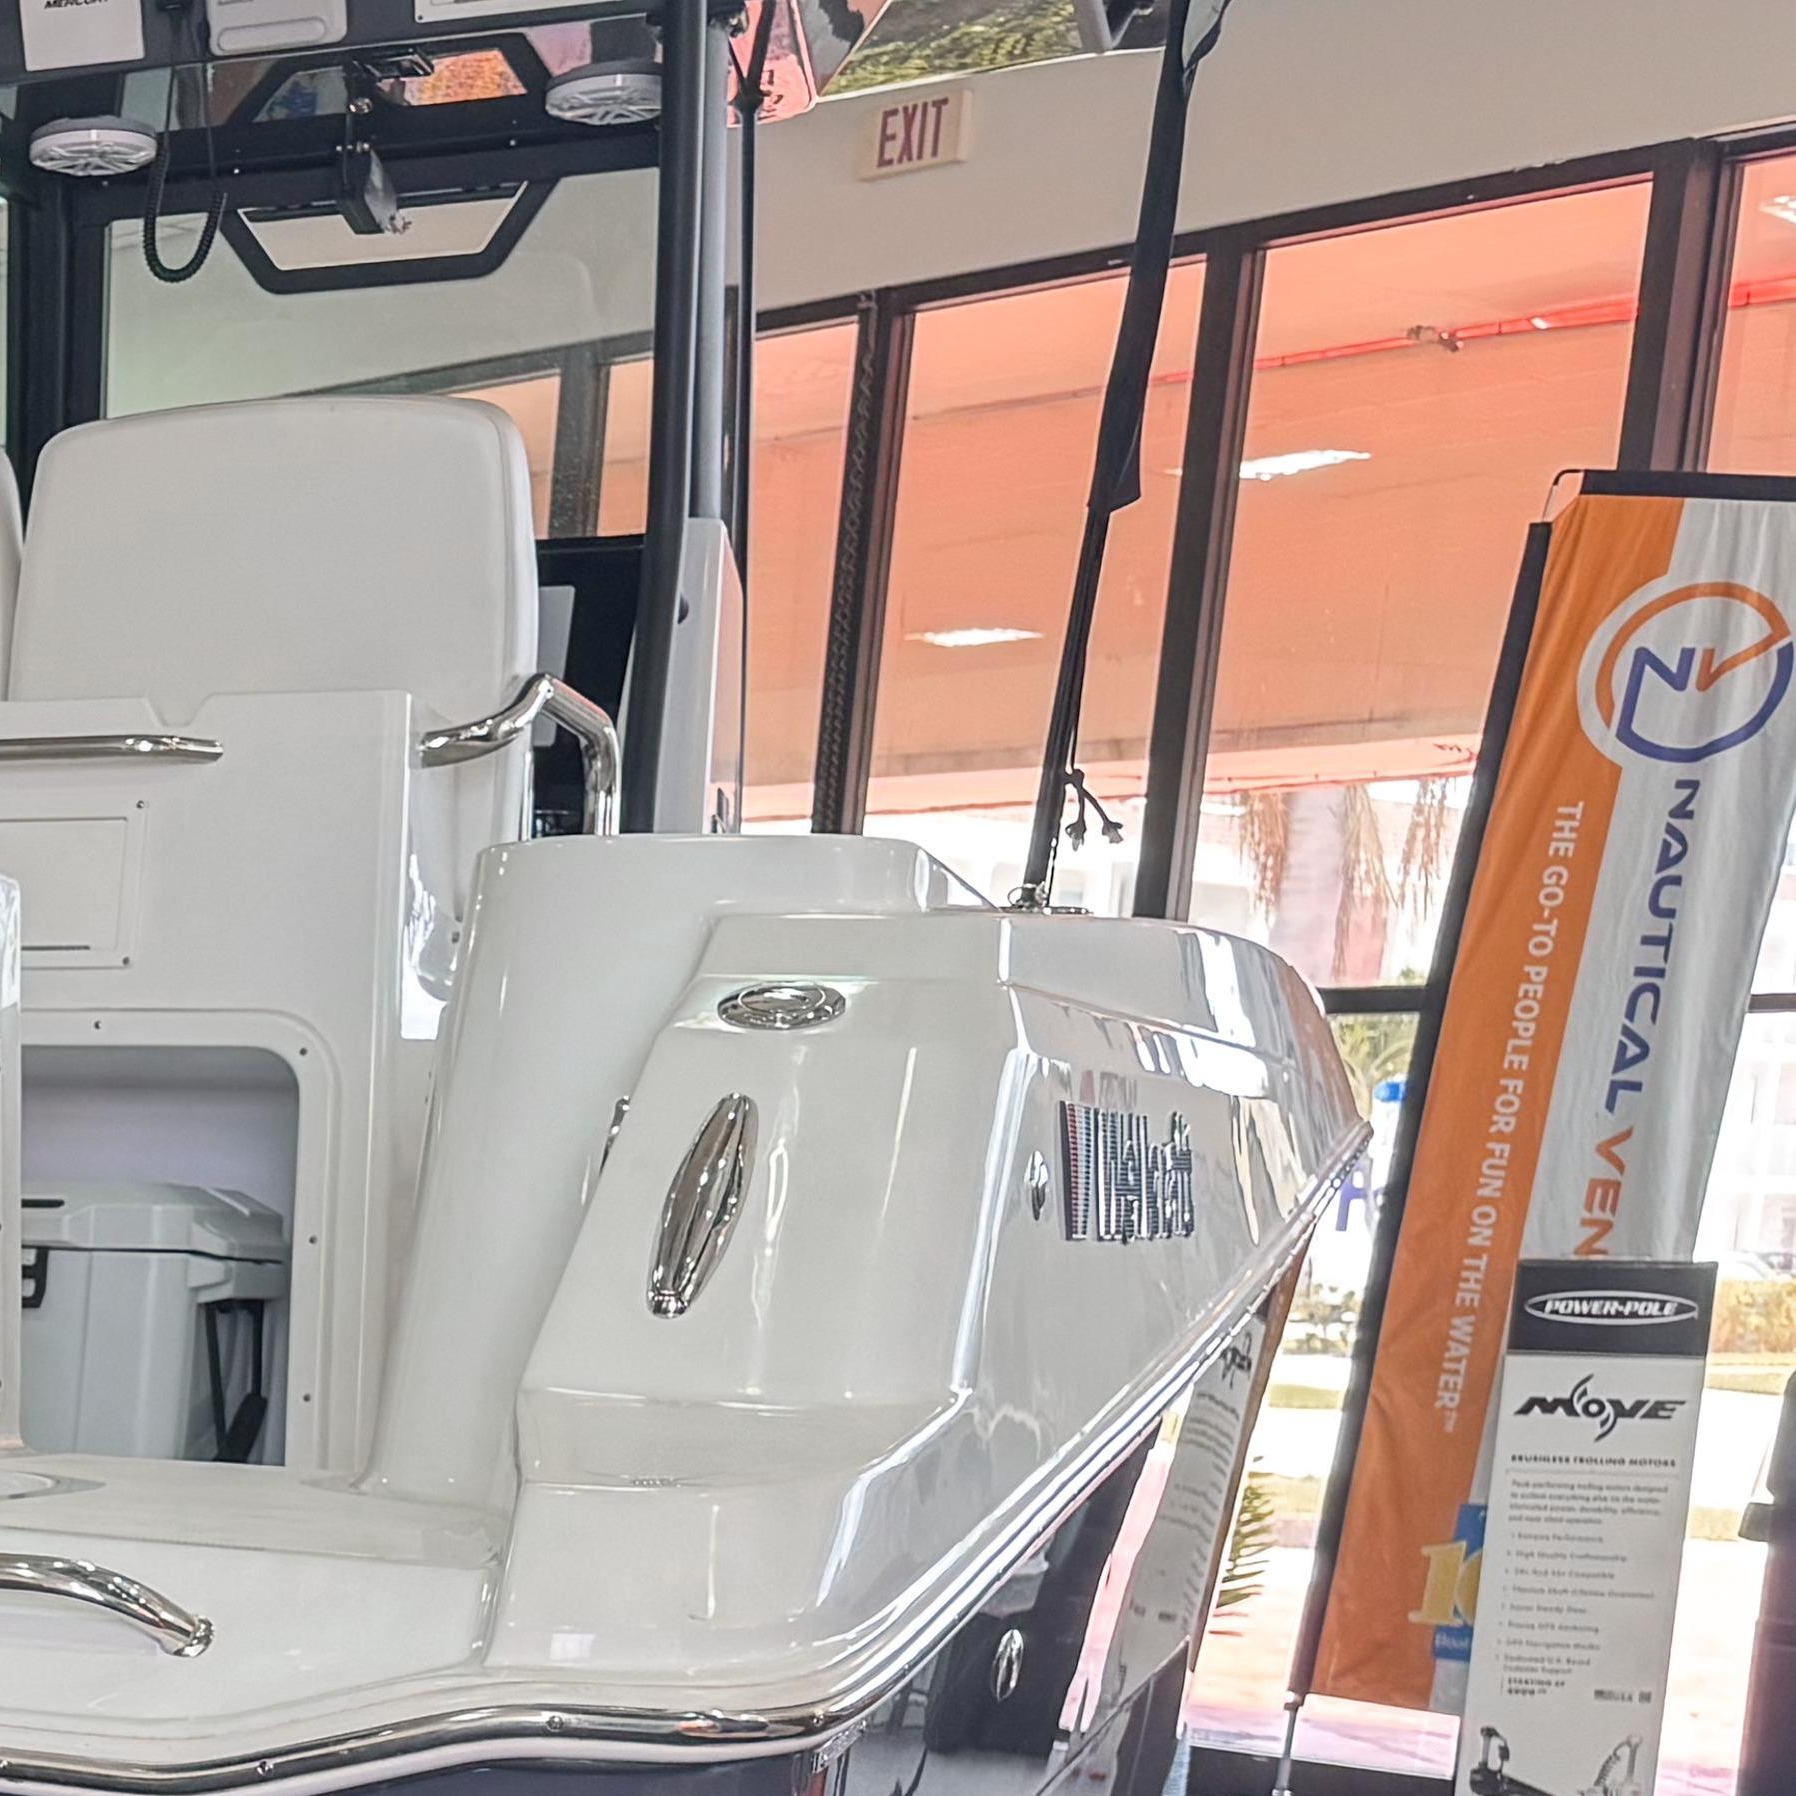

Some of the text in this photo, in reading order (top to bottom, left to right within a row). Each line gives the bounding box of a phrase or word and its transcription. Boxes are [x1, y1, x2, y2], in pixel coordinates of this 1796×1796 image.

[876, 98, 950, 169] EXIT
[1550, 801, 1584, 856] THE
[1527, 866, 1569, 957] GO-TO
[1503, 966, 1548, 1071] PEOPLE
[1575, 778, 1700, 1258] NAUTICAL VEN
[1489, 1078, 1524, 1134] FOR
[1477, 1142, 1512, 1198] FUN
[1467, 1205, 1498, 1247] ON
[1455, 1255, 1489, 1307] THE
[1543, 1299, 1679, 1316] POWER-POLE
[1514, 1388, 1686, 1431] MOVE
